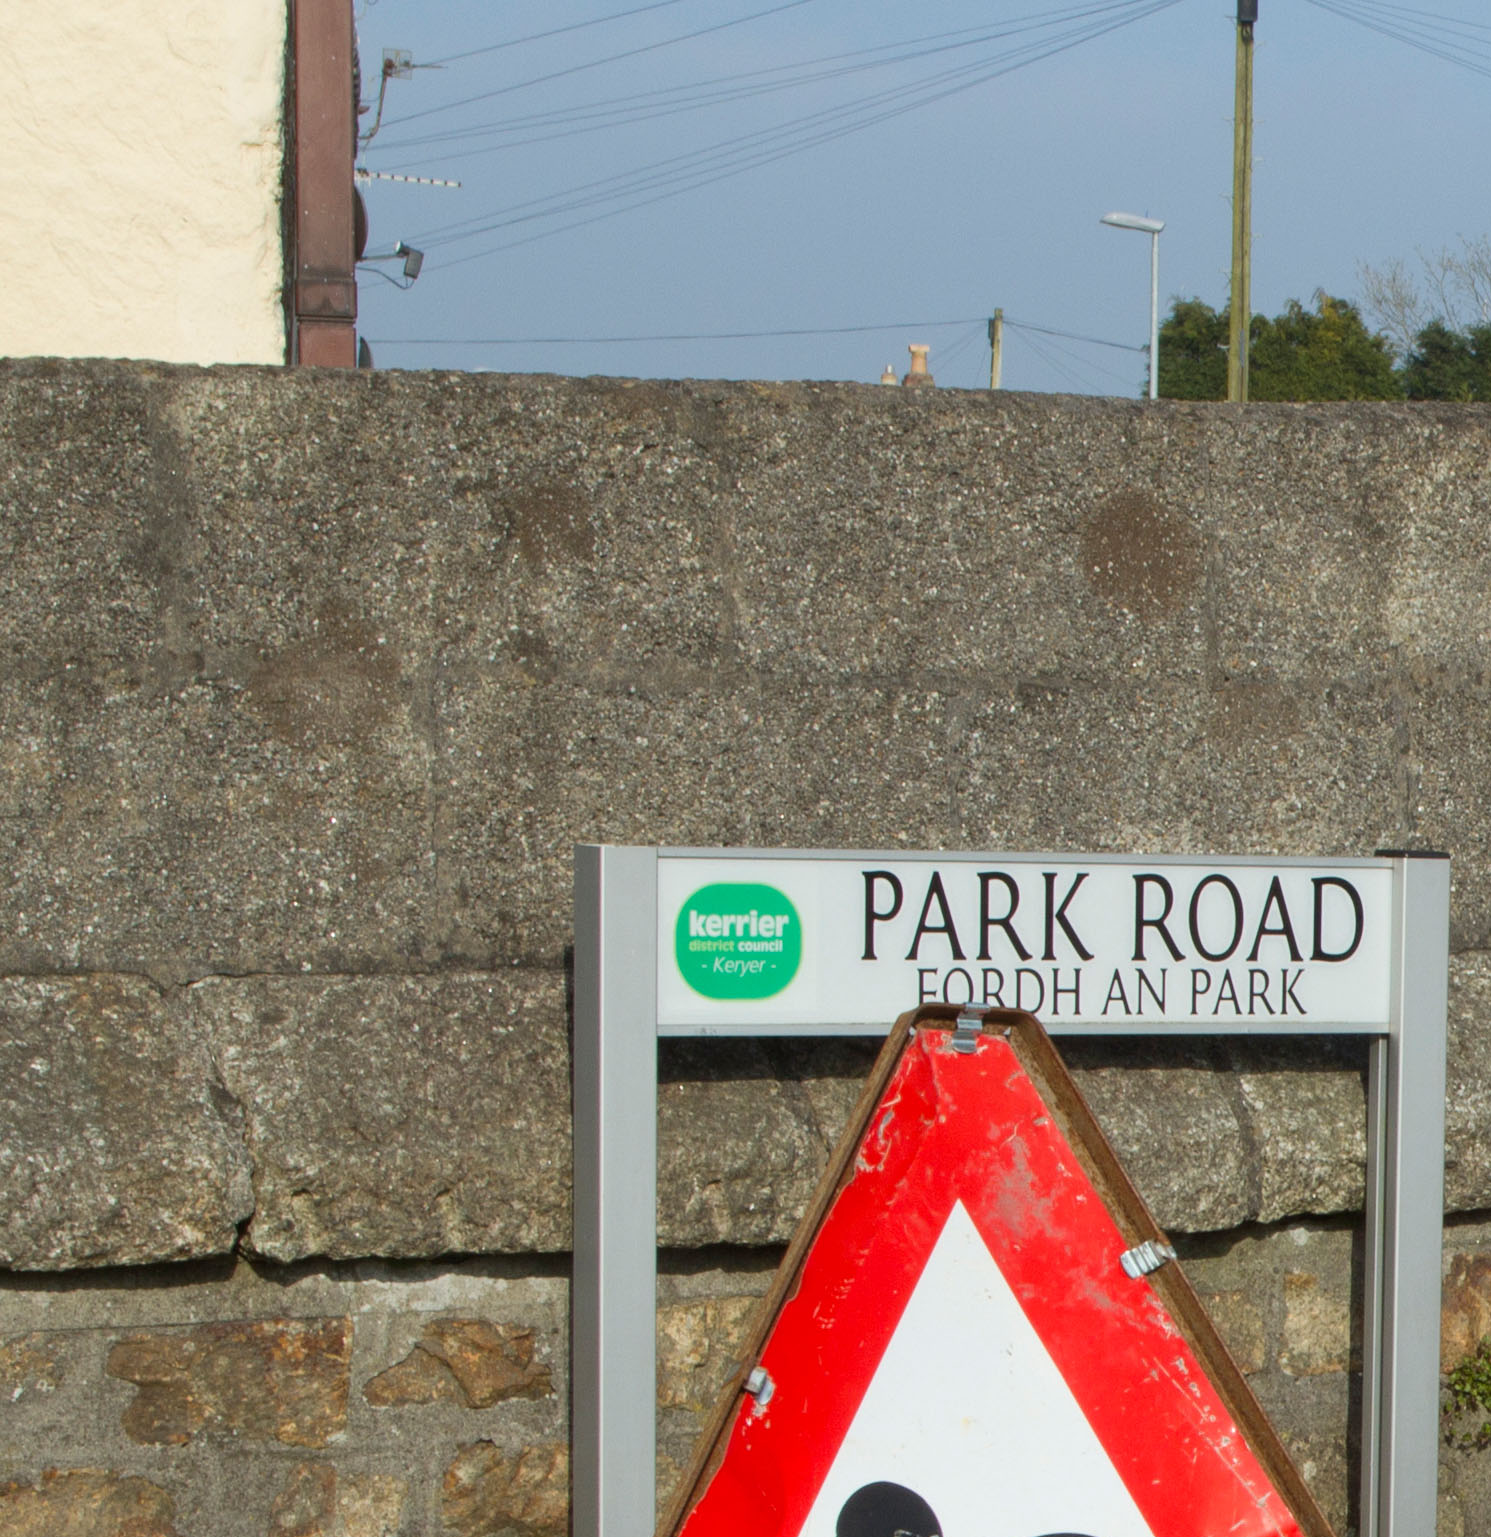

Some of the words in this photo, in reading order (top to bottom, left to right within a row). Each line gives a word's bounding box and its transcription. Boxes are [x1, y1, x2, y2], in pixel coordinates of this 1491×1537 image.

[689, 909, 790, 937] kerrier
[861, 870, 1095, 961] PARK
[1130, 872, 1366, 963] ROAD
[688, 940, 735, 952] district
[737, 940, 783, 952] council
[712, 956, 766, 977] Keryer
[917, 967, 1082, 1015] FORDH
[1102, 967, 1168, 1015] AN
[1190, 968, 1310, 1016] PARK
